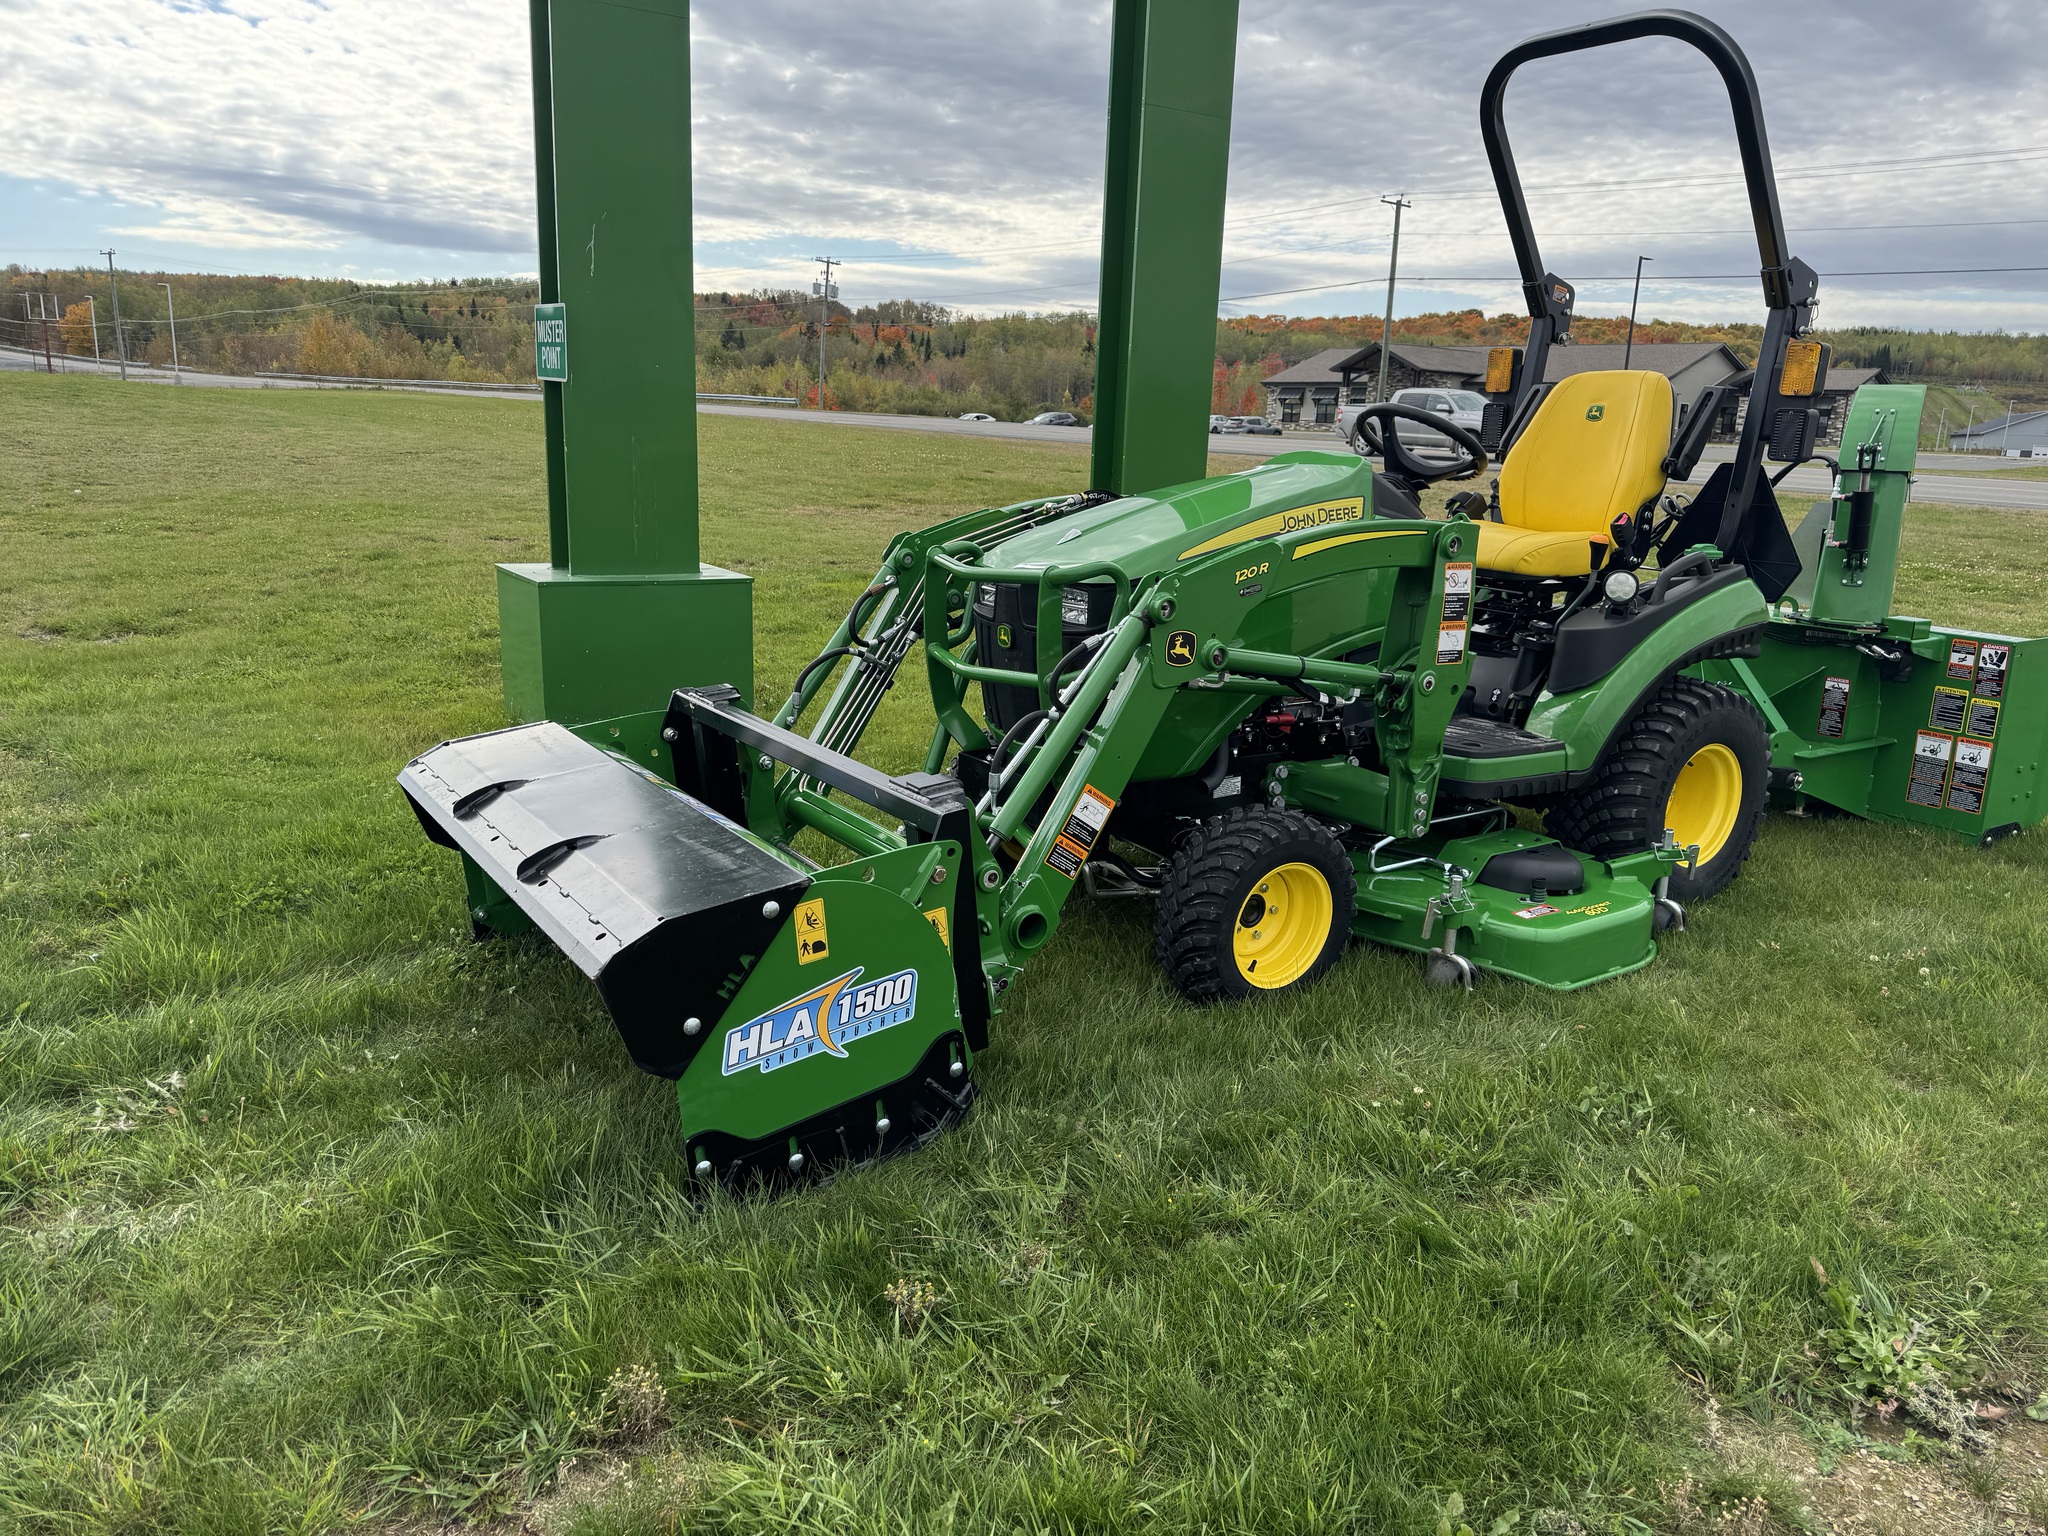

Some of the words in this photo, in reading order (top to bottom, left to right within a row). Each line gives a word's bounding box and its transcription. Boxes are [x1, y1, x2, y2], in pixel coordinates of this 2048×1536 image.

[537, 319, 564, 343] MUSTER
[541, 346, 561, 369] POINT
[1279, 512, 1316, 532] JOHN
[1317, 506, 1358, 524] DEERE
[1941, 687, 1968, 696] ATTENTION
[1977, 699, 2000, 707] CAUTION
[1965, 738, 1990, 748] WARNING
[1092, 791, 1112, 807] WARNING
[1064, 842, 1084, 858] WARNING
[716, 954, 757, 1000] HLA
[726, 1007, 816, 1067] HLA
[838, 973, 914, 1026] 1500
[764, 1042, 815, 1070] SNOW
[840, 1007, 910, 1042] PUSHER
